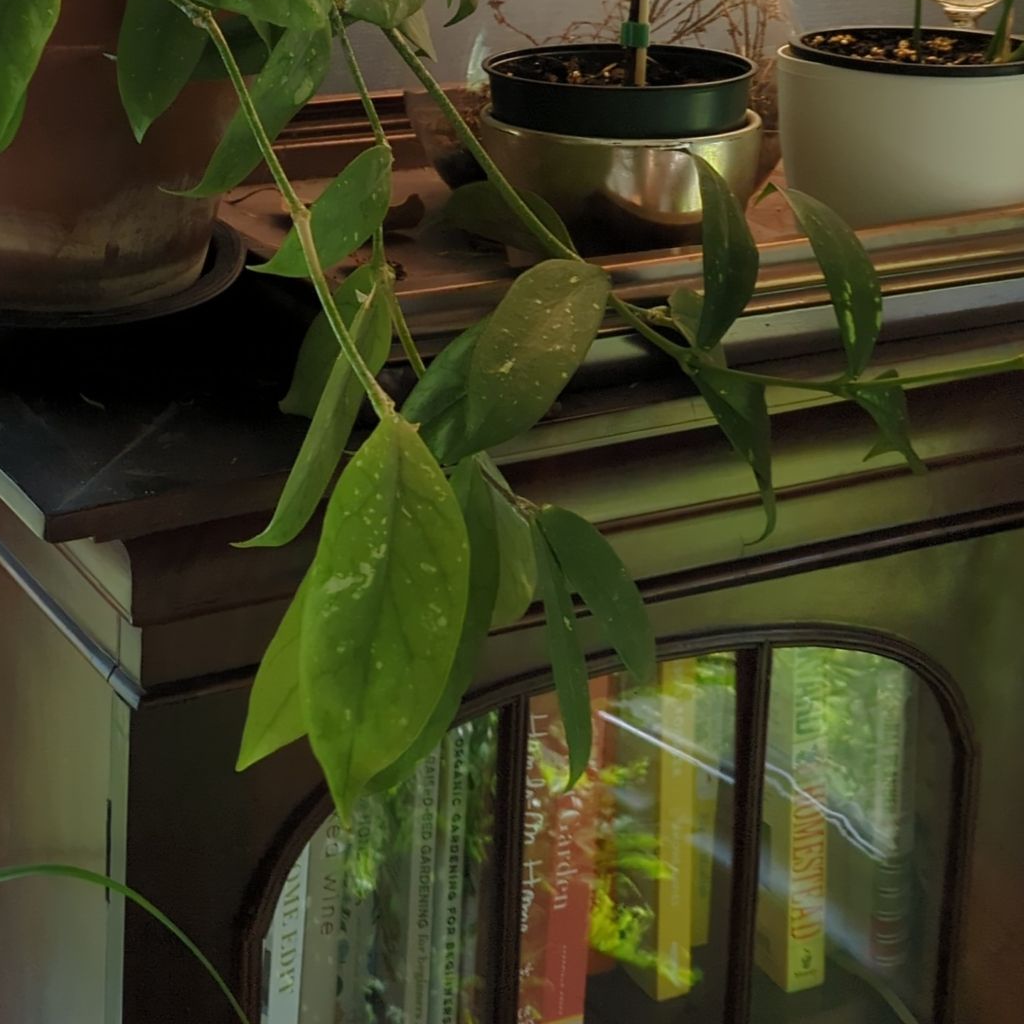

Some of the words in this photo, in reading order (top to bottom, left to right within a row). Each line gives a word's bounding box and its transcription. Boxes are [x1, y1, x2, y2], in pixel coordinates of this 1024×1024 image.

[451, 738, 465, 806] ORGANIC
[416, 845, 432, 929] GARDENING
[447, 814, 462, 901] GARDENING
[791, 784, 826, 940] HOMESTEAD
[320, 872, 340, 936] wine
[446, 907, 457, 936] FOR
[279, 930, 298, 993] EDIT
[417, 934, 429, 952] for
